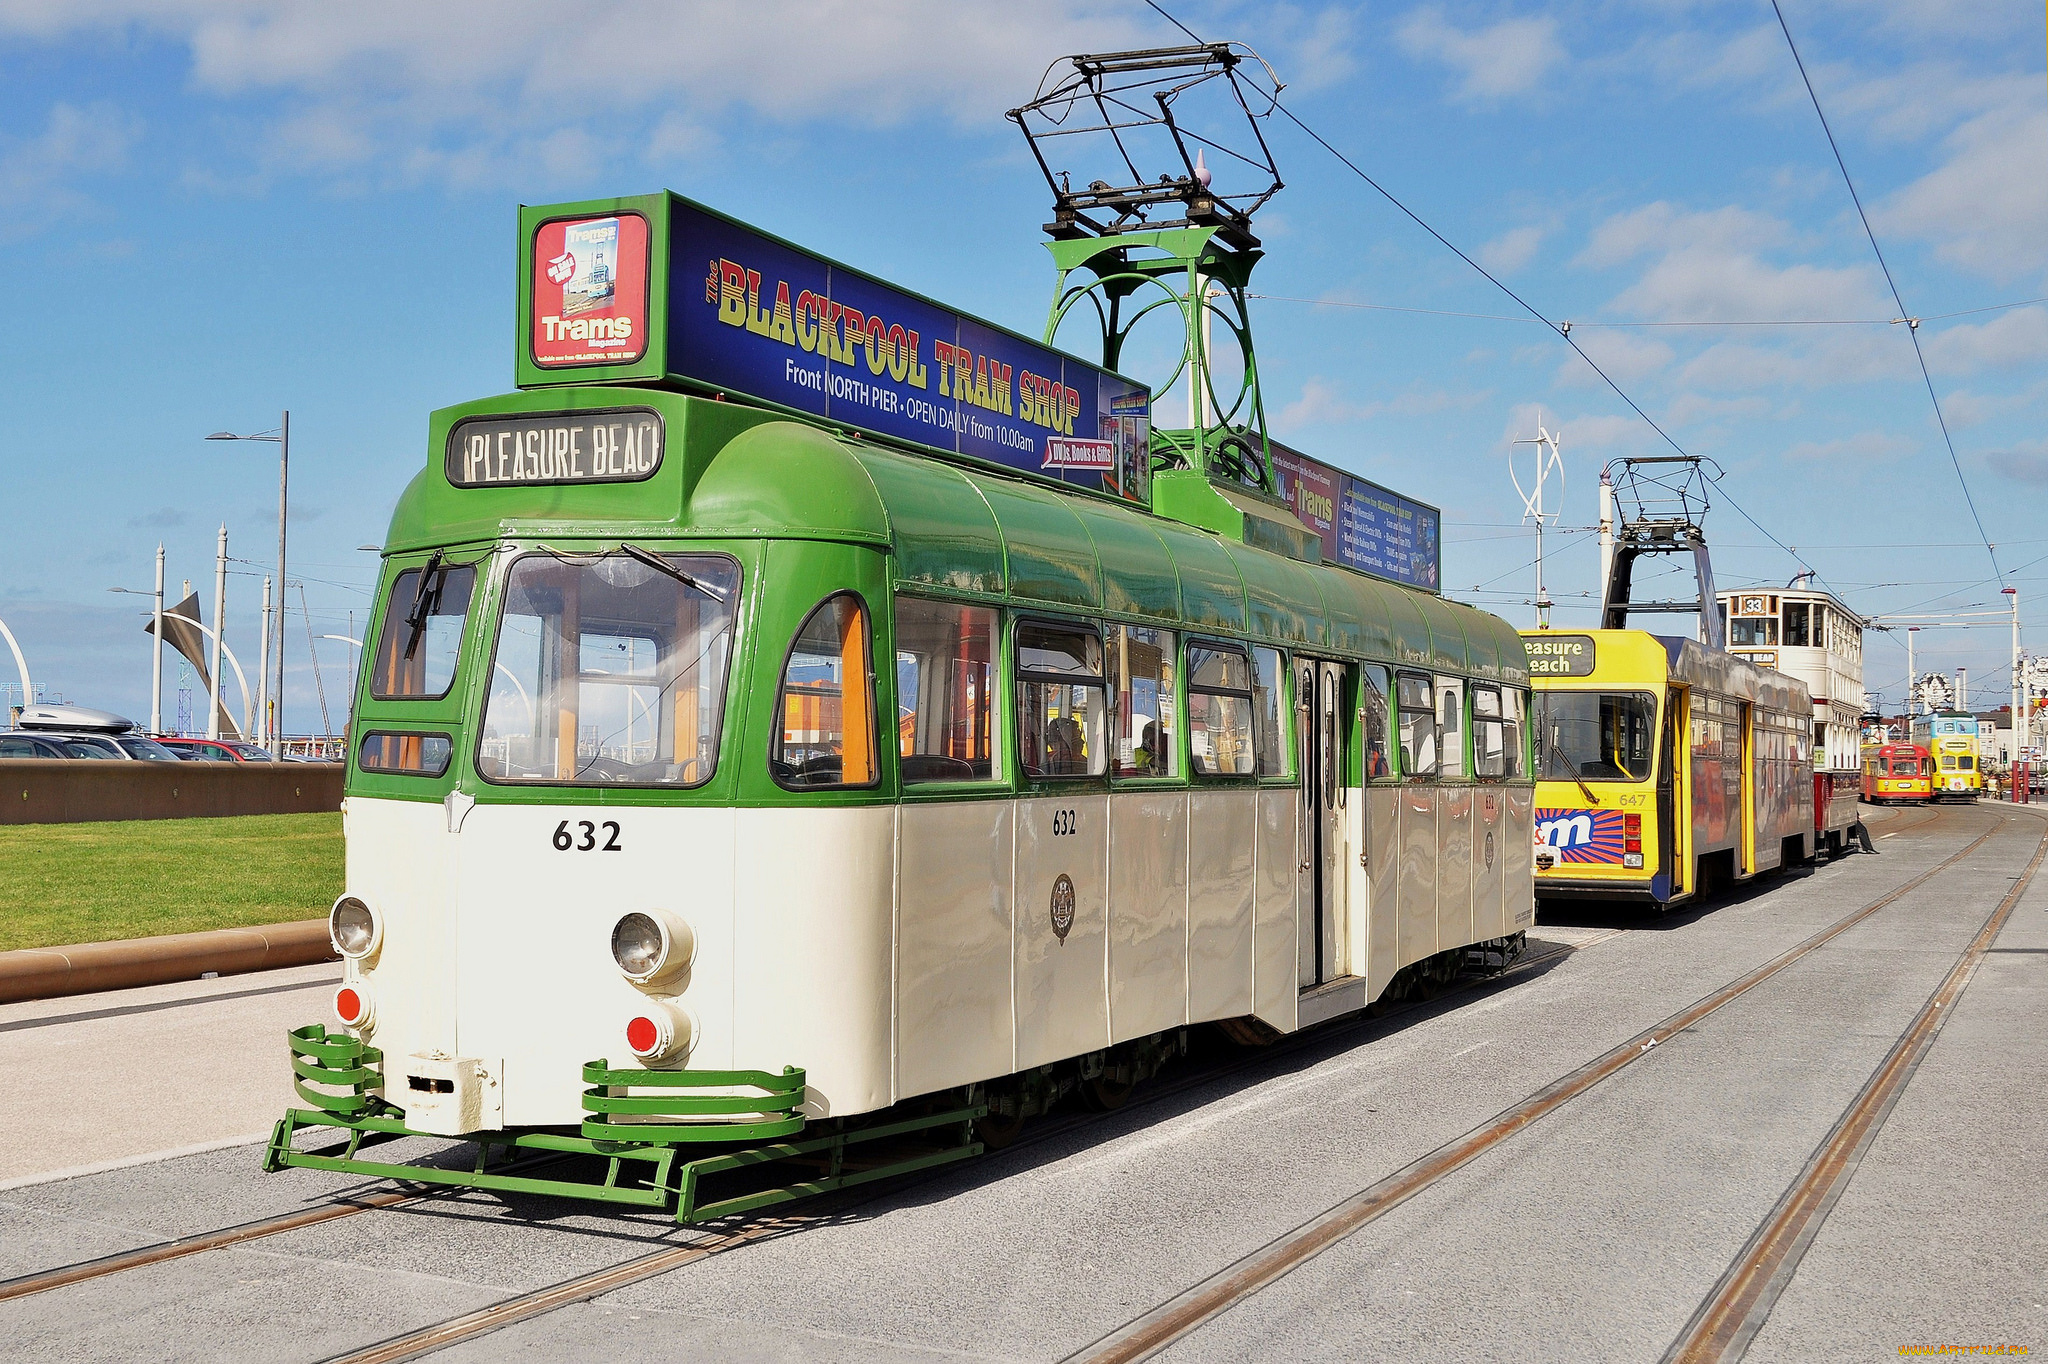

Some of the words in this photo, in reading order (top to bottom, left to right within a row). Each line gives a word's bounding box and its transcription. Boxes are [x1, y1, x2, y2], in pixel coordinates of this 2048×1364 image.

[541, 315, 633, 342] Trams
[588, 338, 626, 348] Magazine
[705, 260, 718, 304] The
[718, 257, 927, 390] BLACKPOOL
[934, 338, 1012, 416] TRAM
[1019, 369, 1080, 436] SHOP
[786, 358, 822, 391] Front
[824, 371, 869, 406] NORTH
[872, 386, 898, 414] PIER
[906, 397, 937, 425] OPEN
[939, 407, 969, 435] DAILY
[970, 415, 994, 442] from
[996, 425, 1034, 452] 10.00am
[470, 426, 584, 482] PLEASURE
[1071, 445, 1091, 462] Books
[1096, 445, 1111, 463] Gifts
[1294, 479, 1333, 522] Trams
[1746, 599, 1762, 613] 33
[1524, 642, 1583, 655] easure
[1734, 653, 1751, 662] ER
[1753, 653, 1774, 662] HEAD
[1529, 655, 1570, 672] each
[1619, 794, 1646, 806] 647
[1053, 809, 1076, 836] 632
[552, 820, 622, 851] 632
